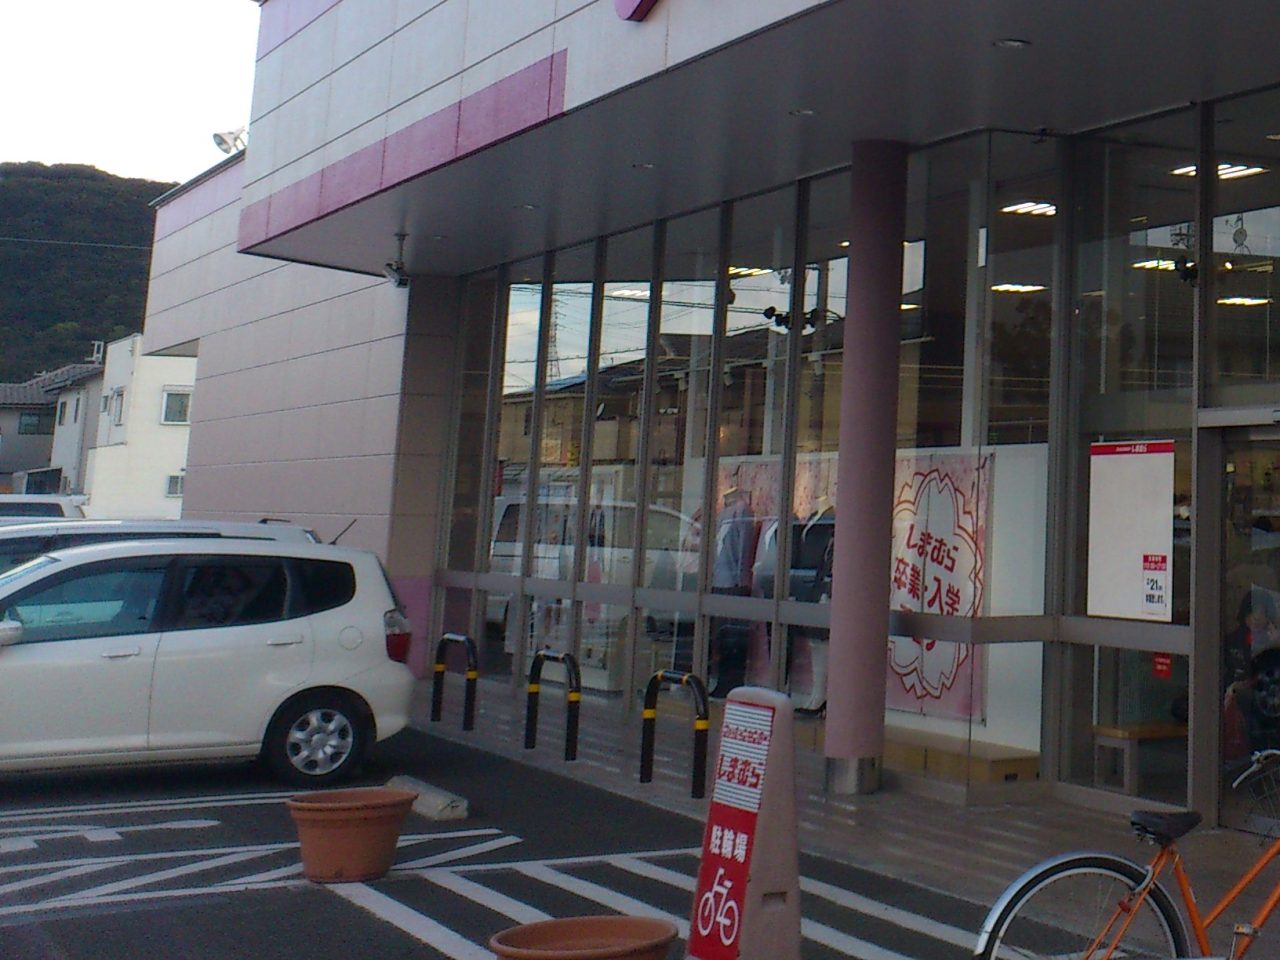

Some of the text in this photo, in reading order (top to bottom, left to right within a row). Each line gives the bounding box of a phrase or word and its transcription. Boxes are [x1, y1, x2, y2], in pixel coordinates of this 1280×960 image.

[906, 523, 959, 573] しまむら
[714, 753, 764, 789] しまむら
[709, 824, 749, 864] 駐輪場
